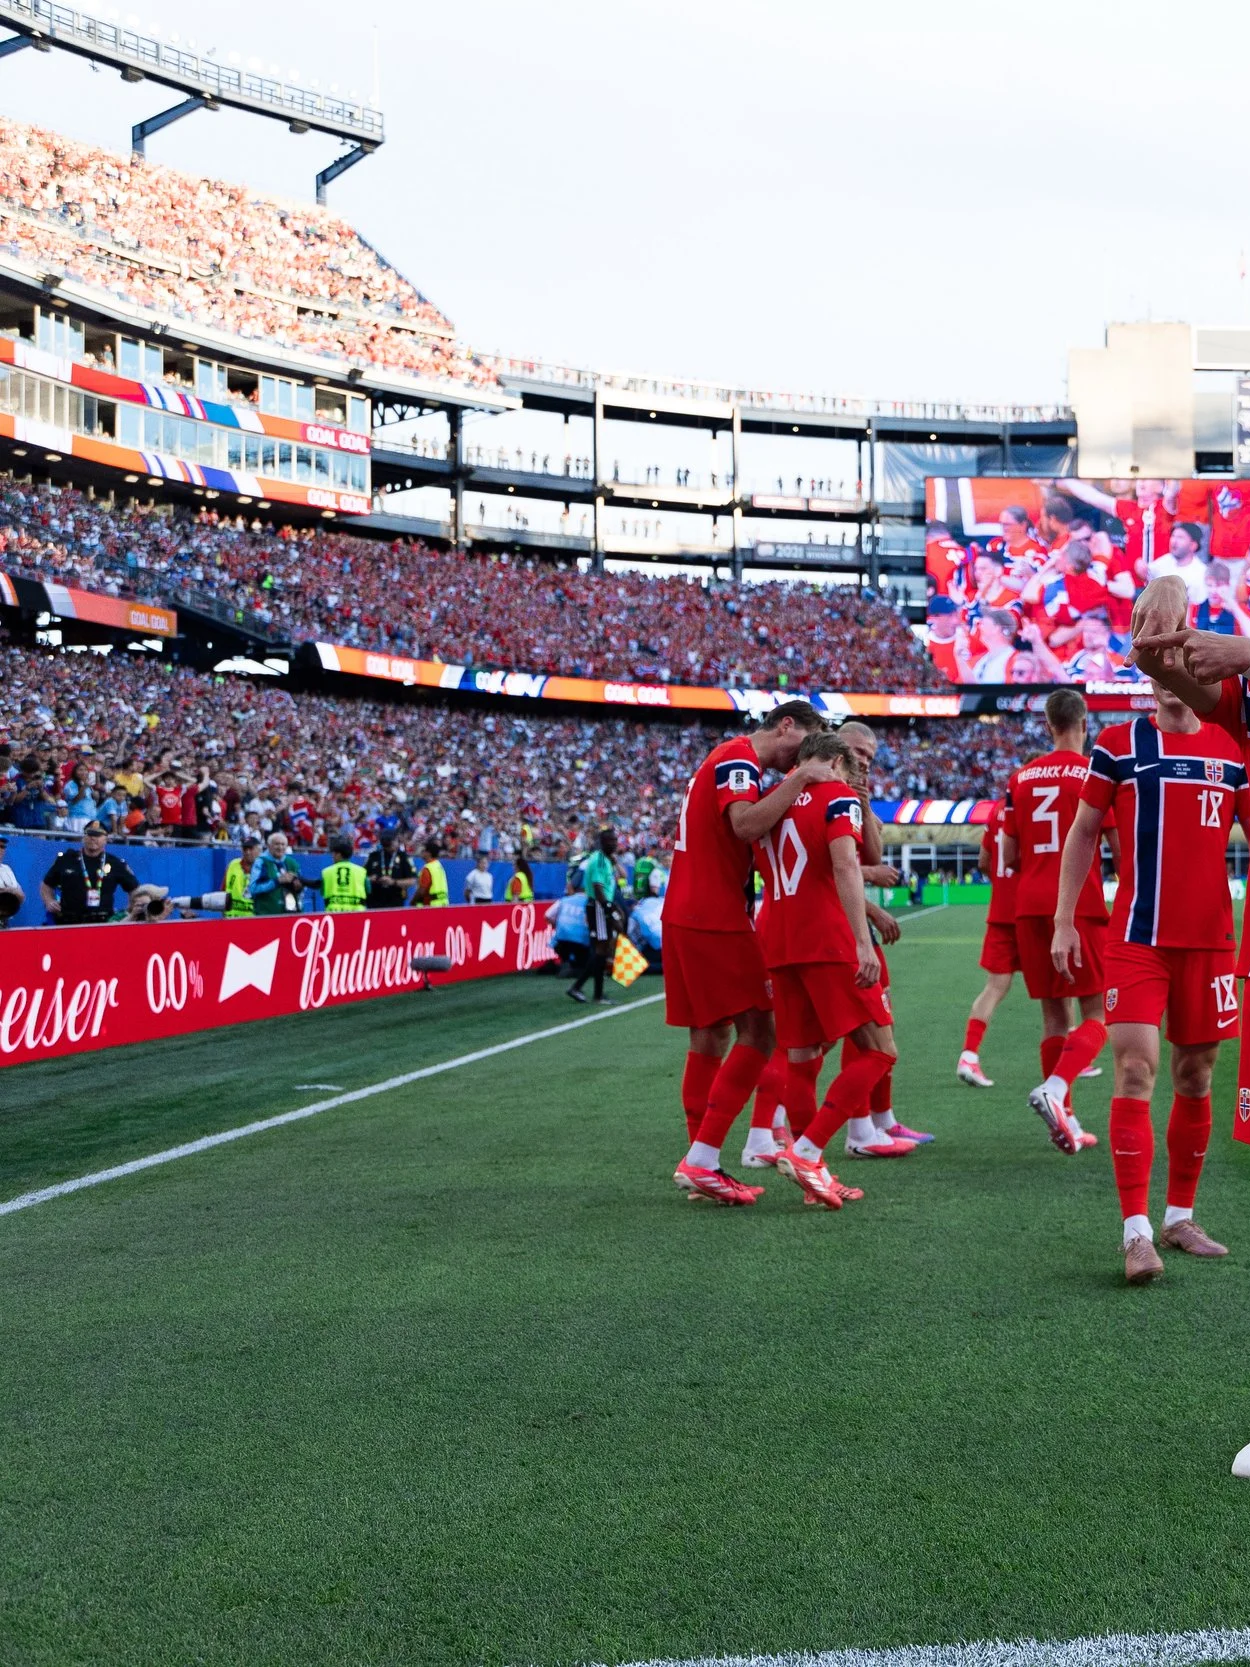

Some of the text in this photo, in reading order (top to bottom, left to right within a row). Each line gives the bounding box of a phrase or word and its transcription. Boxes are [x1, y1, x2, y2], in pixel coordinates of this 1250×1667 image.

[306, 425, 370, 453] GOAL GOAL
[307, 488, 371, 515] GOAL GOAL
[604, 684, 670, 705] GOAL GOAL
[889, 696, 959, 715] GOAL GOAL
[1032, 786, 1060, 854] 3
[1197, 790, 1224, 828] 18
[758, 817, 809, 901] 10
[0, 950, 204, 1054] eiser 0.0%
[1210, 973, 1238, 1012] 18
